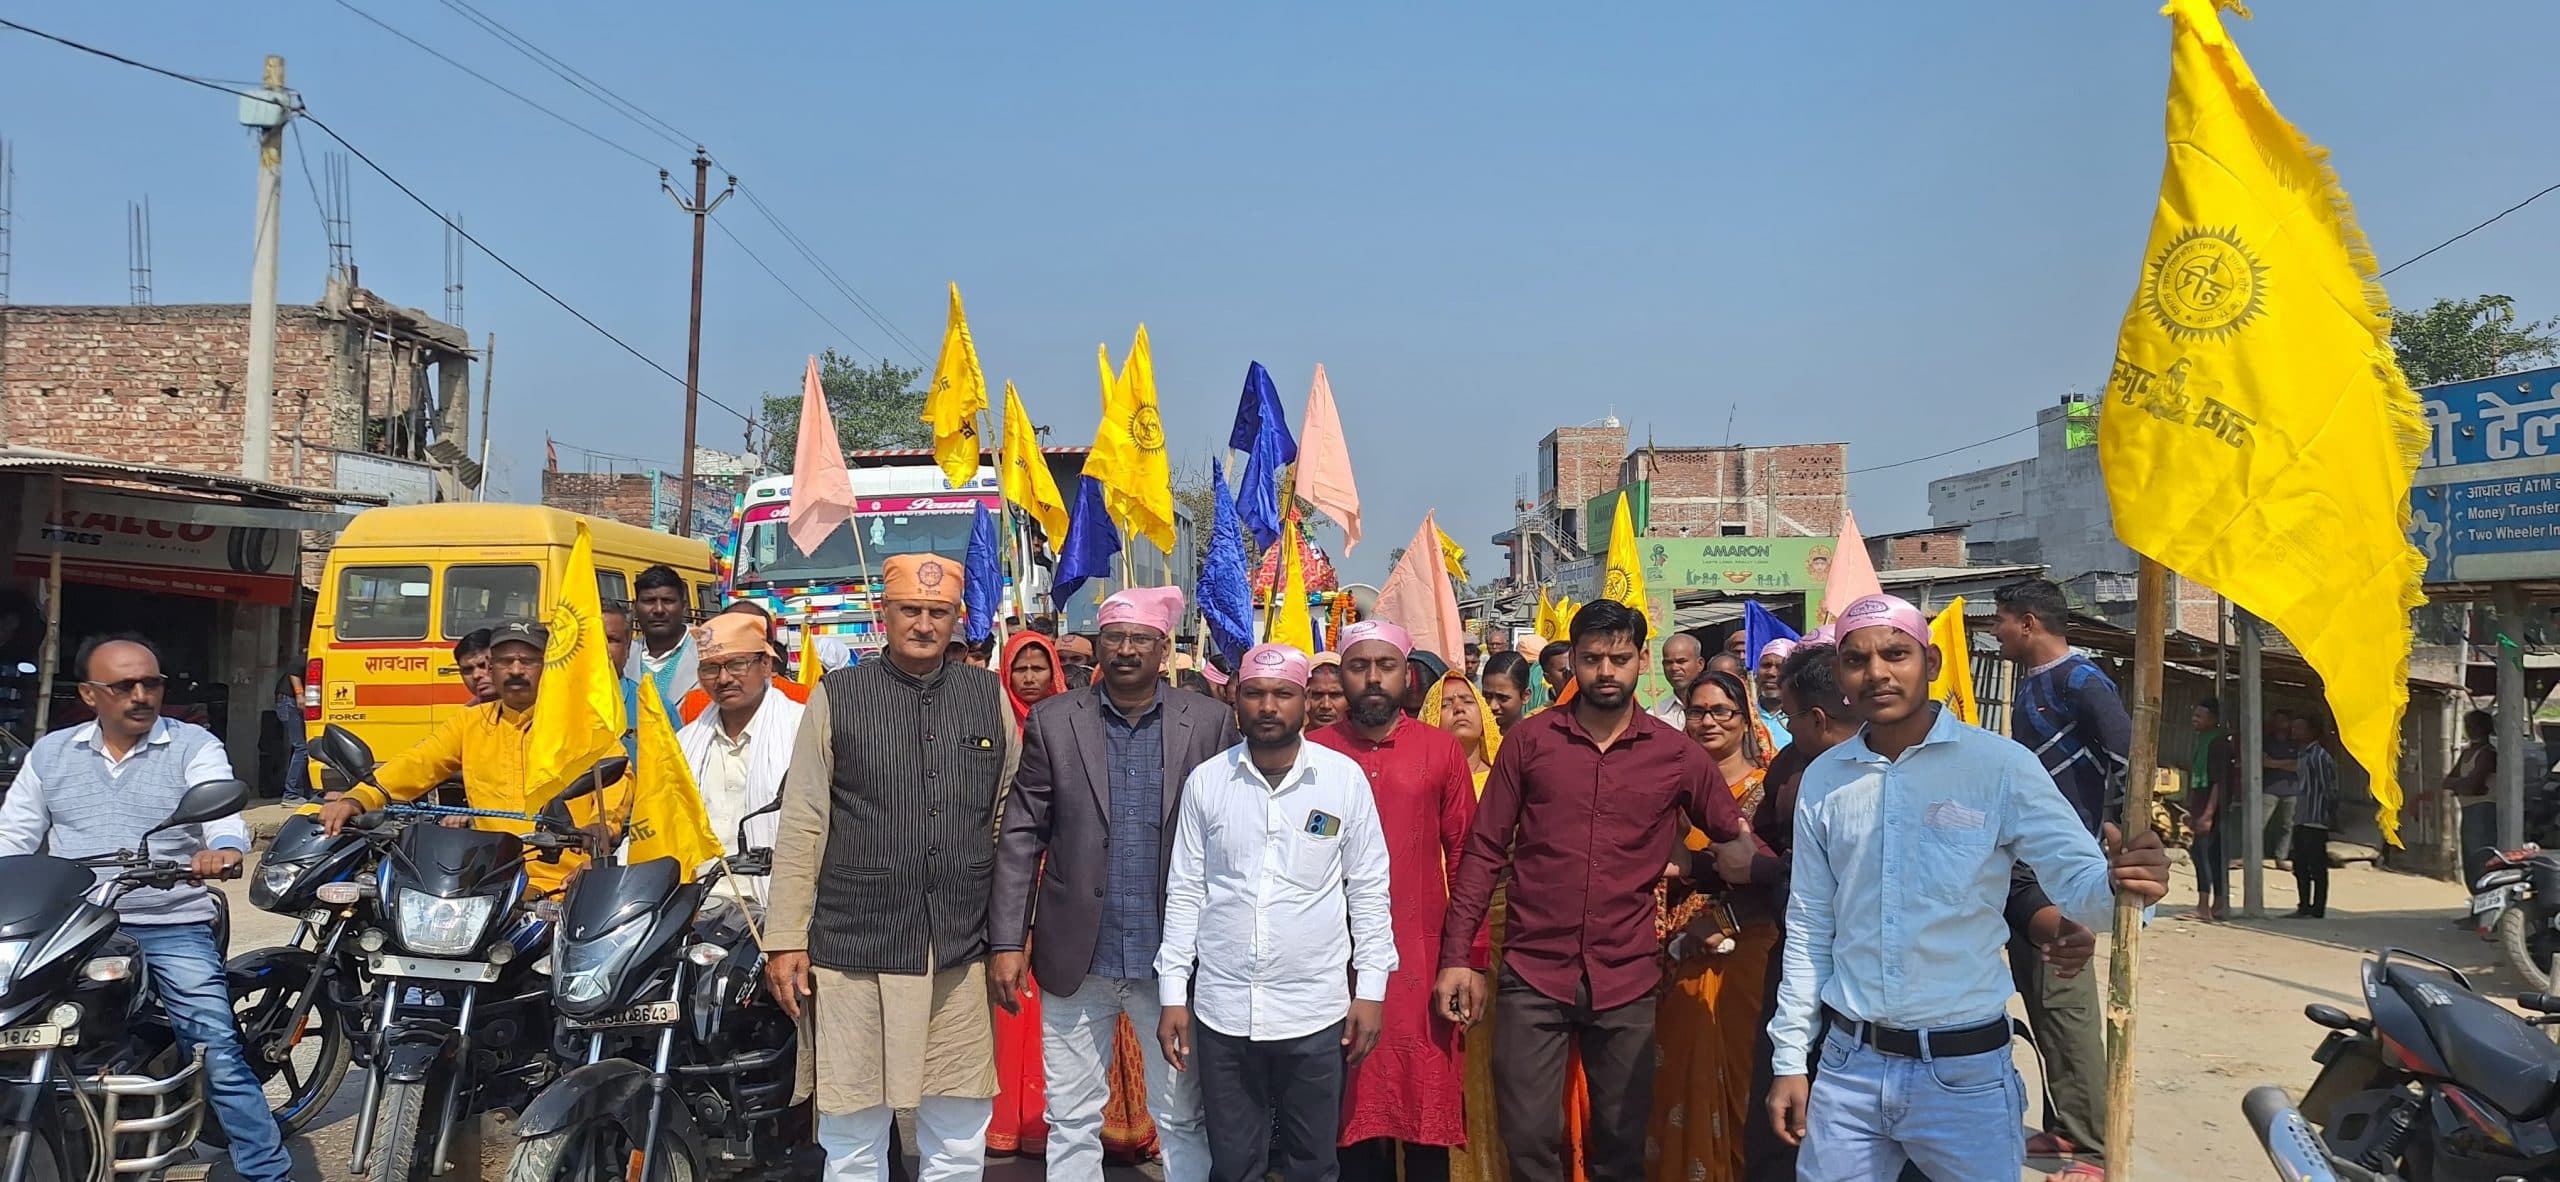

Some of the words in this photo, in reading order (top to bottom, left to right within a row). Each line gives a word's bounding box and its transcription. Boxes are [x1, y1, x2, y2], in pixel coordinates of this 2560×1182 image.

[2525, 478, 2551, 493] ATM
[2467, 507, 2505, 521] Money
[2509, 502, 2560, 516] Transfer
[40, 527, 103, 546] TRES
[2468, 527, 2493, 541] Two
[2496, 525, 2545, 540] Wheeler
[1702, 544, 1770, 558] AMARON
[365, 656, 429, 674] सावधान
